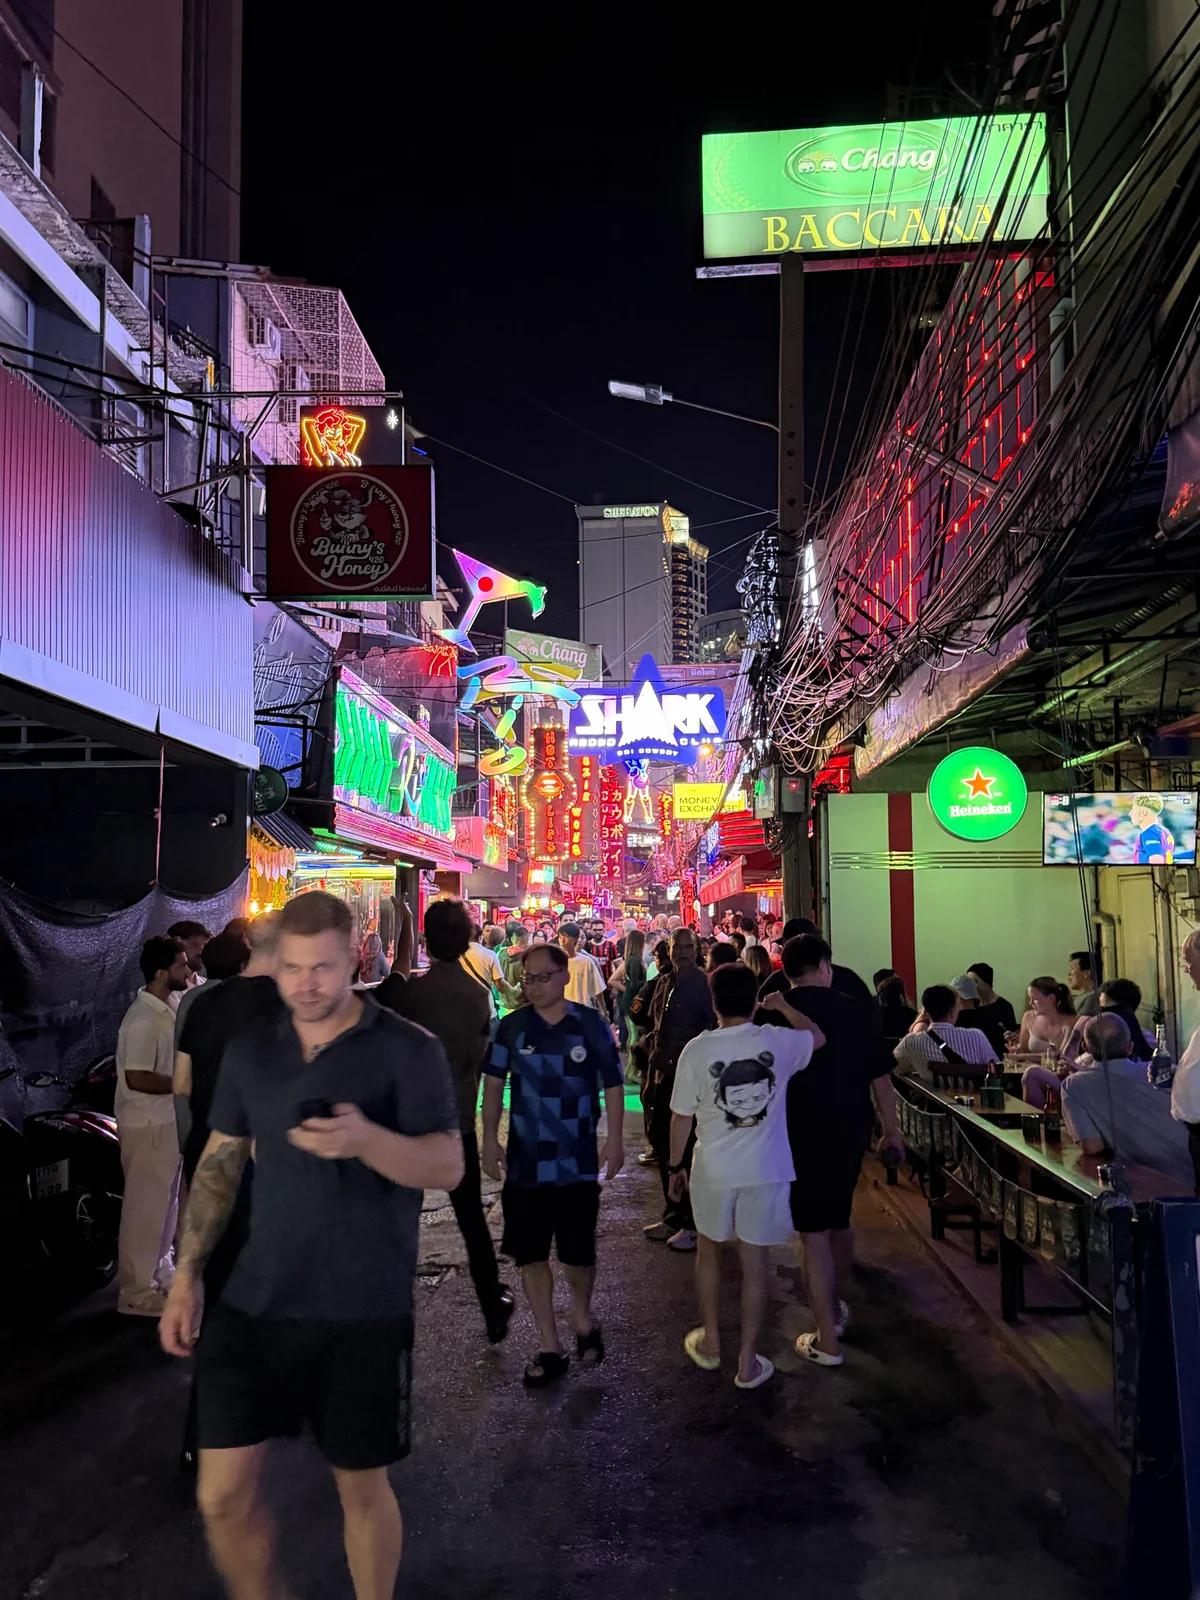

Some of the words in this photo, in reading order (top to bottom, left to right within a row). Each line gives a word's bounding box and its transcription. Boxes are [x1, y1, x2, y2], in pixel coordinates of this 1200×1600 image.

[842, 147, 938, 173] Chang
[763, 204, 1003, 252] BACCARA
[603, 506, 660, 518] SHERATON
[310, 536, 386, 560] Bunny's
[368, 555, 385, 564] 420
[320, 555, 390, 581] Honey
[540, 640, 588, 668] Chang
[575, 680, 720, 747] SHARK
[679, 796, 719, 804] MONEY
[679, 804, 739, 813] EXCHAGE
[950, 803, 1012, 818] Heineken
